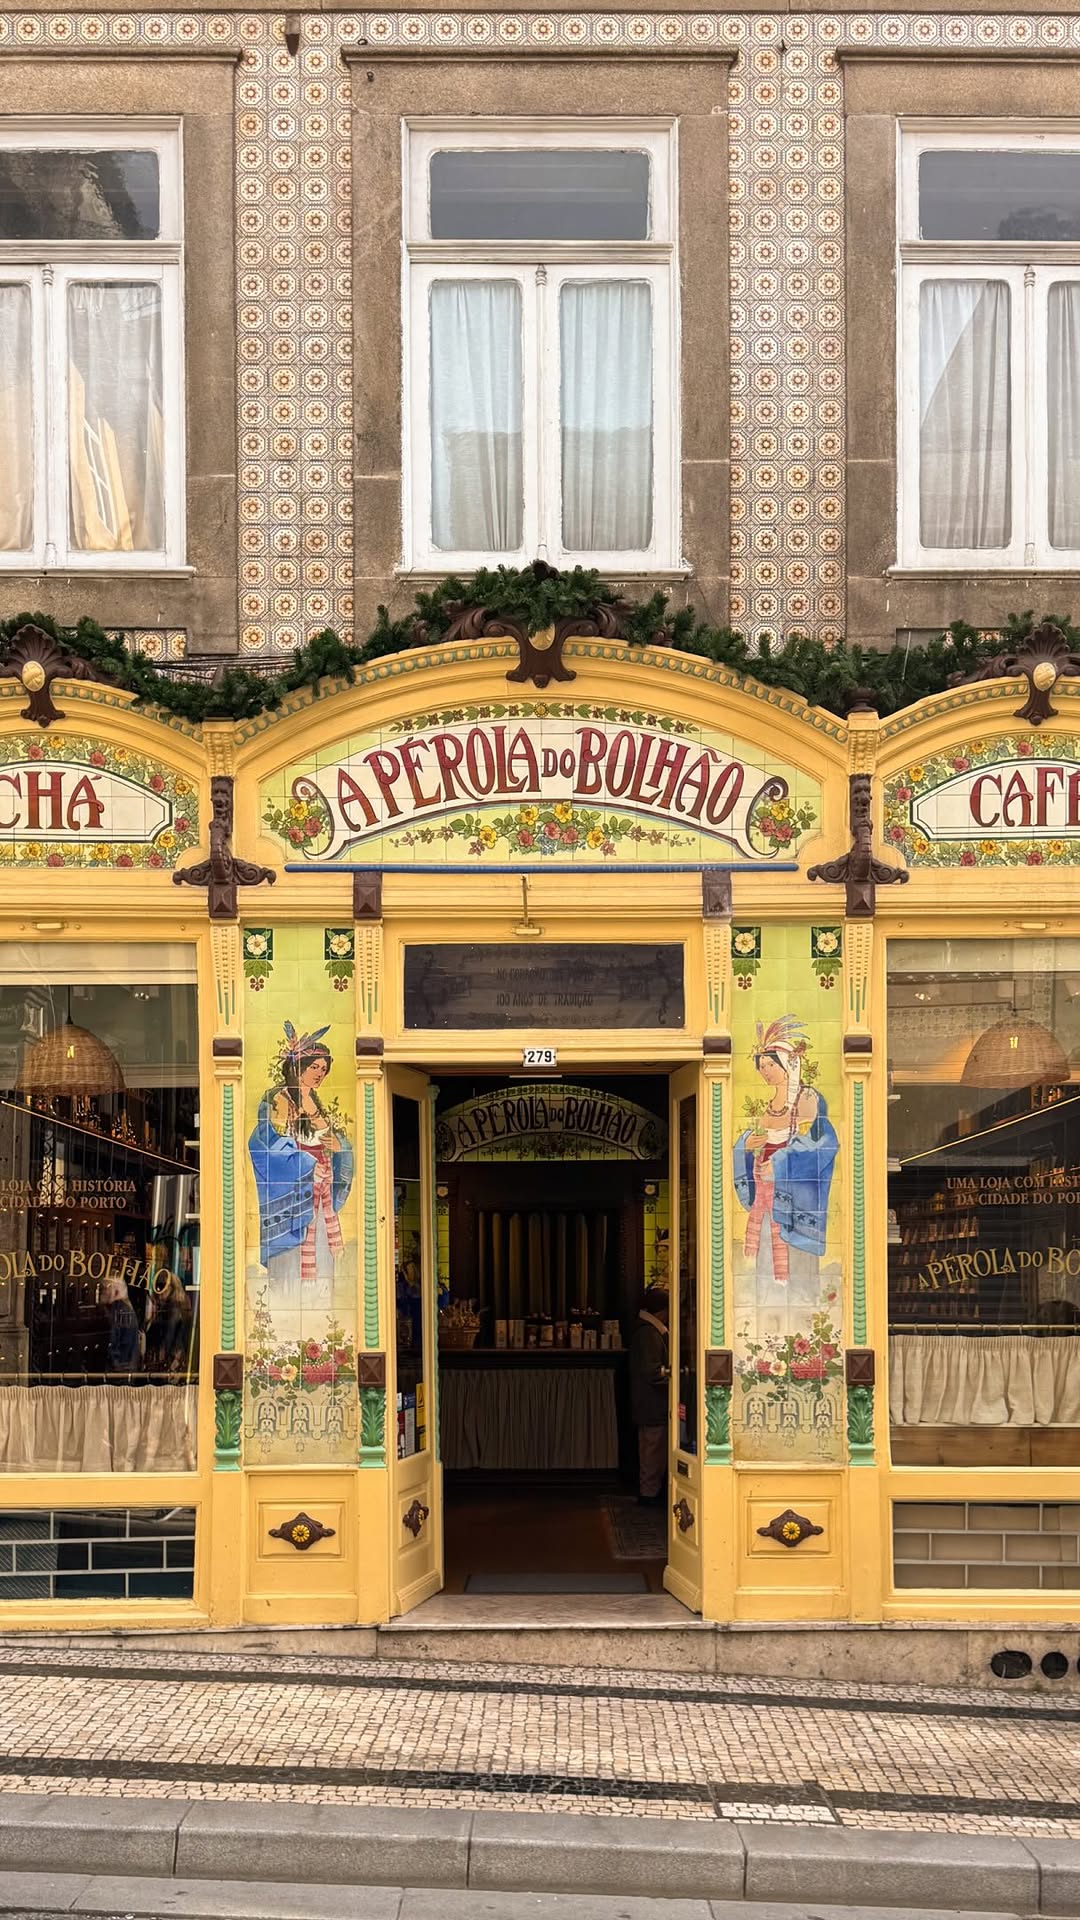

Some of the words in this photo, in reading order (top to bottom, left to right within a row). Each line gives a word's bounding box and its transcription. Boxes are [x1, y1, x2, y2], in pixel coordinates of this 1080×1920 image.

[338, 768, 380, 832] A
[362, 725, 542, 818] PÉROLA
[541, 748, 576, 778] DO
[573, 726, 745, 825] BOLHÃO
[0, 770, 105, 831] CHÁ
[527, 1050, 553, 1064] 279
[457, 1116, 478, 1148] A
[470, 1095, 550, 1140] PÉROLA
[563, 1096, 638, 1144] BOLHÃO
[72, 1176, 137, 1192] HISTÓRIA
[947, 1177, 977, 1189] UMA
[980, 1177, 1011, 1191] LOJA
[1014, 1176, 1045, 1189] COM
[80, 1196, 127, 1208] PORTO
[957, 1192, 975, 1205] DA
[978, 1192, 1029, 1205] CIDADE
[1032, 1192, 1054, 1204] DO
[38, 1254, 65, 1271] DO
[918, 1272, 929, 1290] A
[926, 1247, 1018, 1290] PÉROLA
[1017, 1251, 1043, 1268] DO
